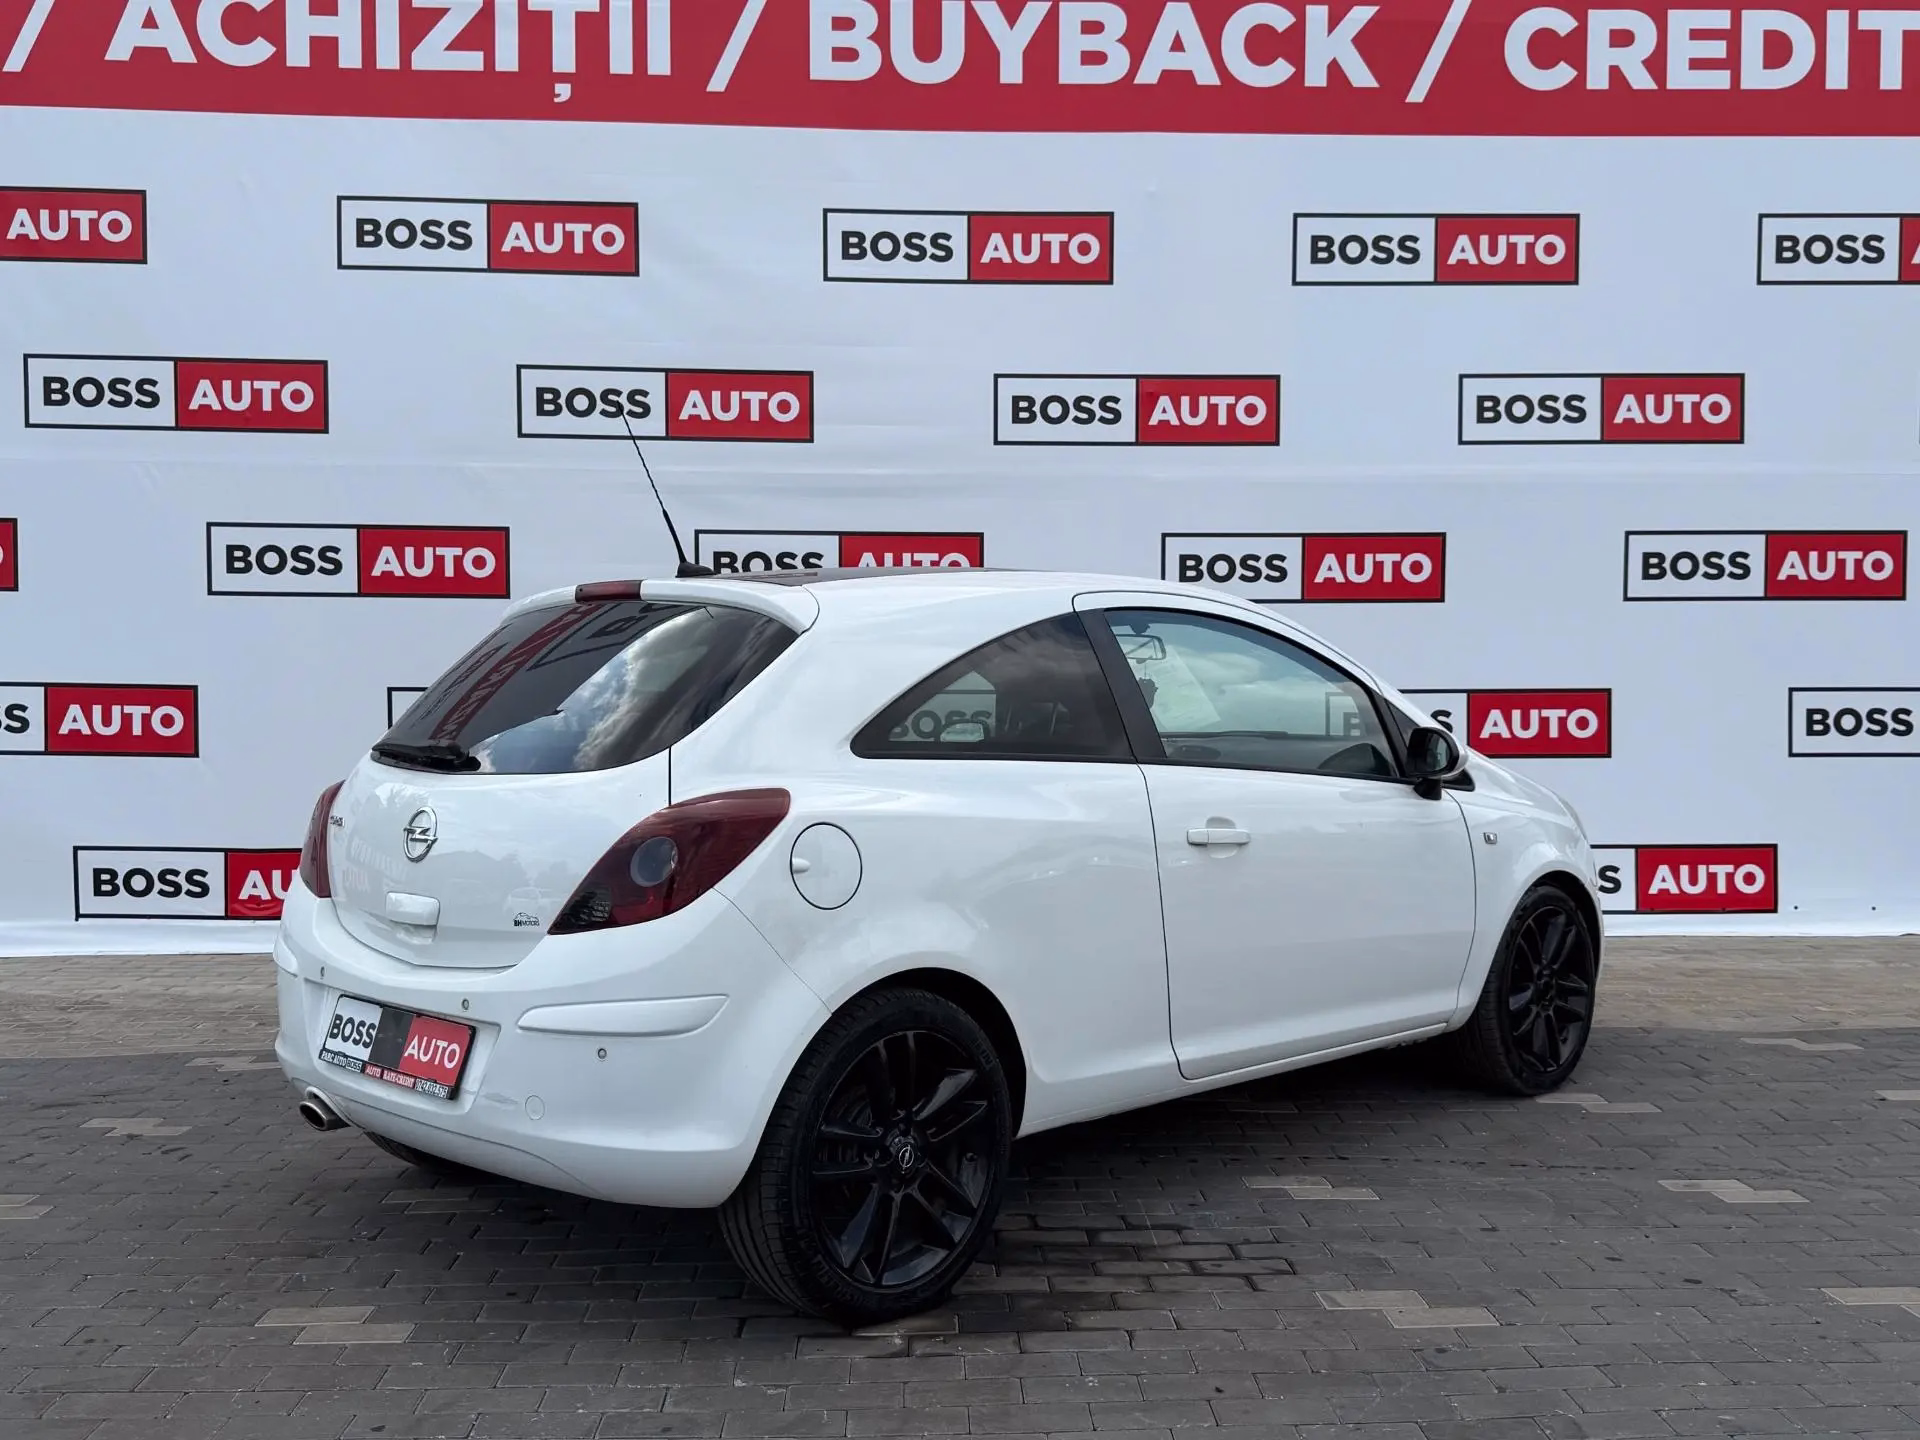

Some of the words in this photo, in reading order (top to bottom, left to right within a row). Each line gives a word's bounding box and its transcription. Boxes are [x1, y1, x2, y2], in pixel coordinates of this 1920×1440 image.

[810, 0, 1380, 87] BUYBACK
[1505, 7, 1920, 90] CREDIT
[6, 208, 133, 243] AUTO
[355, 218, 473, 251] BOSS
[500, 221, 625, 256] AUTO
[841, 230, 954, 263] BOSS
[979, 232, 1101, 265] AUTO
[1310, 234, 1421, 265] BOSS
[1446, 234, 1566, 266] AUTO
[1775, 234, 1885, 265] BOSS
[42, 376, 161, 409] BOSS
[188, 379, 314, 413] AUTO
[535, 386, 652, 421] BOSS
[678, 389, 800, 423] AUTO
[1011, 394, 1122, 425] BOSS
[1148, 395, 1267, 426] AUTO
[1476, 394, 1587, 424] BOSS
[1613, 393, 1732, 425] AUTO
[225, 544, 343, 576] BOSS
[371, 546, 496, 579] AUTO
[1178, 553, 1288, 584] BOSS
[1313, 552, 1433, 584] AUTO
[1641, 551, 1751, 581] BOSS
[1776, 550, 1894, 581] AUTO
[58, 703, 185, 737] AUTO
[1479, 708, 1599, 739] AUTO
[1805, 707, 1914, 737] BOSS
[92, 867, 211, 899] BOSS
[1648, 863, 1765, 895] AUTO
[329, 1013, 377, 1049] BOSS
[404, 1034, 461, 1069] AUTO
[333, 1055, 347, 1067] AUTO
[365, 1065, 382, 1078] AUTO
